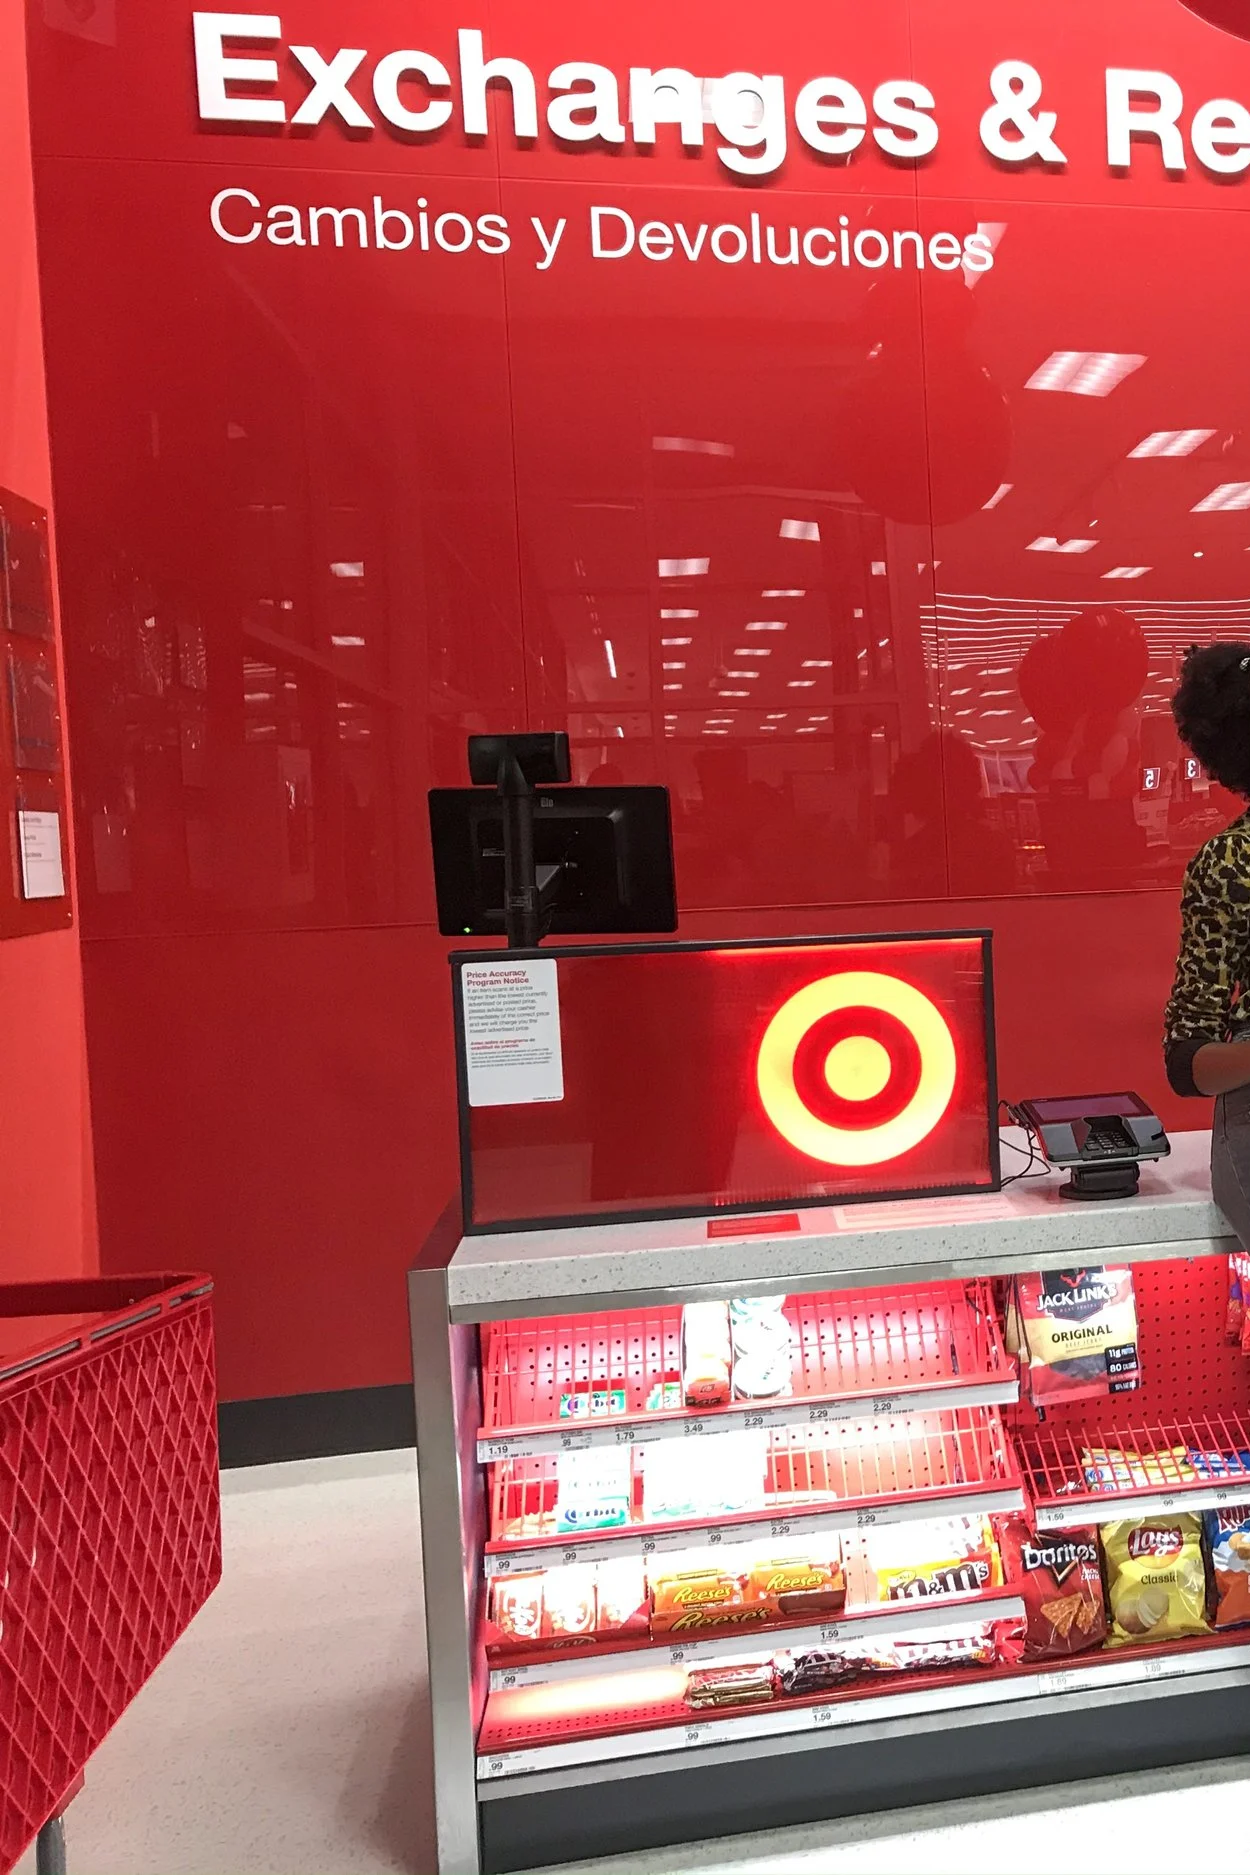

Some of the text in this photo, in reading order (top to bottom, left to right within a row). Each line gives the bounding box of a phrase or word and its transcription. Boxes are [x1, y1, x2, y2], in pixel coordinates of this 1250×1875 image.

[193, 12, 939, 176] Exchanges
[979, 60, 1068, 165] &
[210, 188, 995, 272] Cambios y Devoluciones
[489, 969, 527, 977] Accuracy
[467, 979, 501, 987] Program
[1037, 1290, 1074, 1311] JACK
[1051, 1324, 1113, 1343] ORIGINAL
[1110, 1363, 1122, 1373] 80
[873, 1403, 892, 1412] 2.29
[809, 1410, 828, 1419] 2.29
[744, 1417, 763, 1426] 2.29
[684, 1424, 703, 1433] 3.49
[615, 1431, 635, 1441] 1.79
[489, 1446, 508, 1454] 1.19
[857, 1515, 876, 1524] 2.29
[771, 1526, 790, 1535] 2.29
[765, 1572, 825, 1591] Reese's
[1141, 1572, 1178, 1585] Classic
[673, 1584, 733, 1604] Reese's
[820, 1629, 839, 1640] 1.59
[813, 1712, 832, 1722] 1.59
